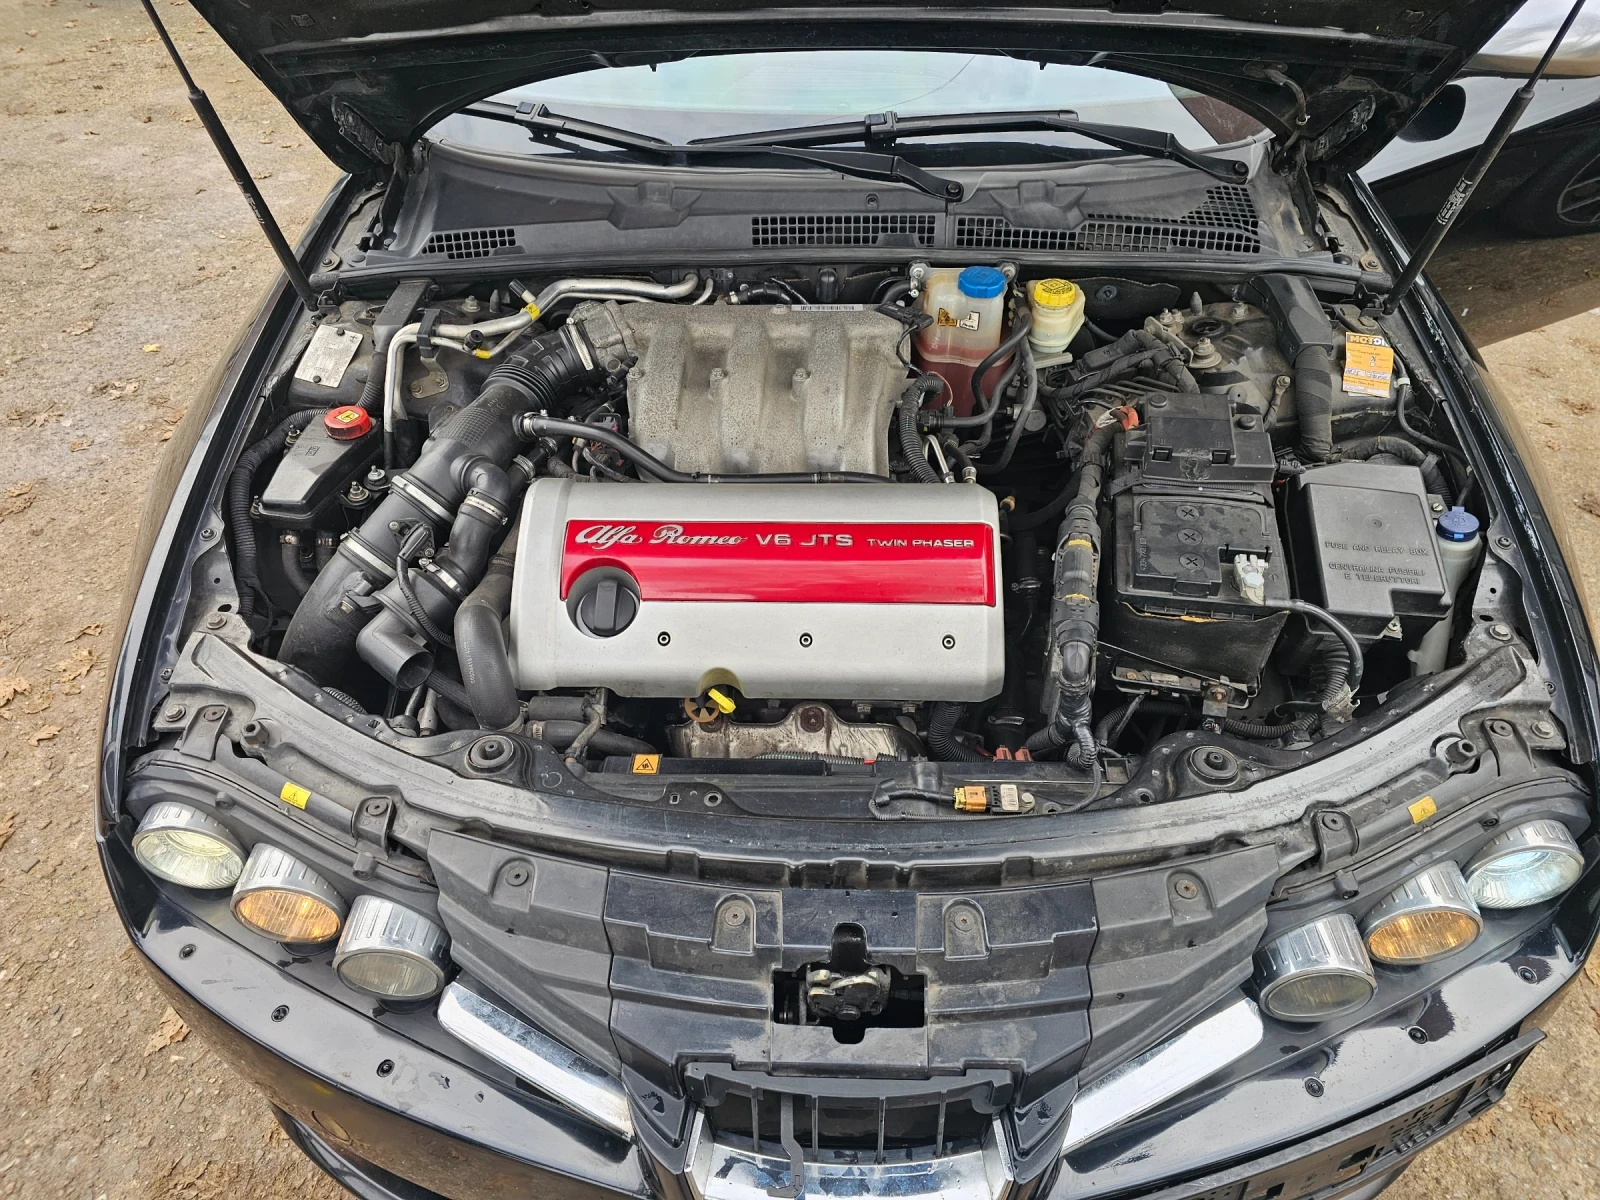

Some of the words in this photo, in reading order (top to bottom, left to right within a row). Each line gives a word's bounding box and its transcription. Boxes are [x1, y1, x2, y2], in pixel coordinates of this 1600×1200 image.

[575, 524, 643, 550] Alfa
[649, 524, 748, 546] Romeo
[755, 533, 791, 546] V6
[800, 533, 853, 547] JTS
[867, 538, 907, 547] TWIN
[912, 539, 975, 548] PHASER
[1324, 541, 1348, 550] FUSE
[1352, 544, 1370, 552] AND
[1374, 545, 1404, 554] RELAY
[1409, 548, 1428, 556] BOX
[1328, 562, 1384, 574] CENTRALINA
[1344, 572, 1352, 580] E
[1356, 573, 1420, 585] TELERUTTORI
